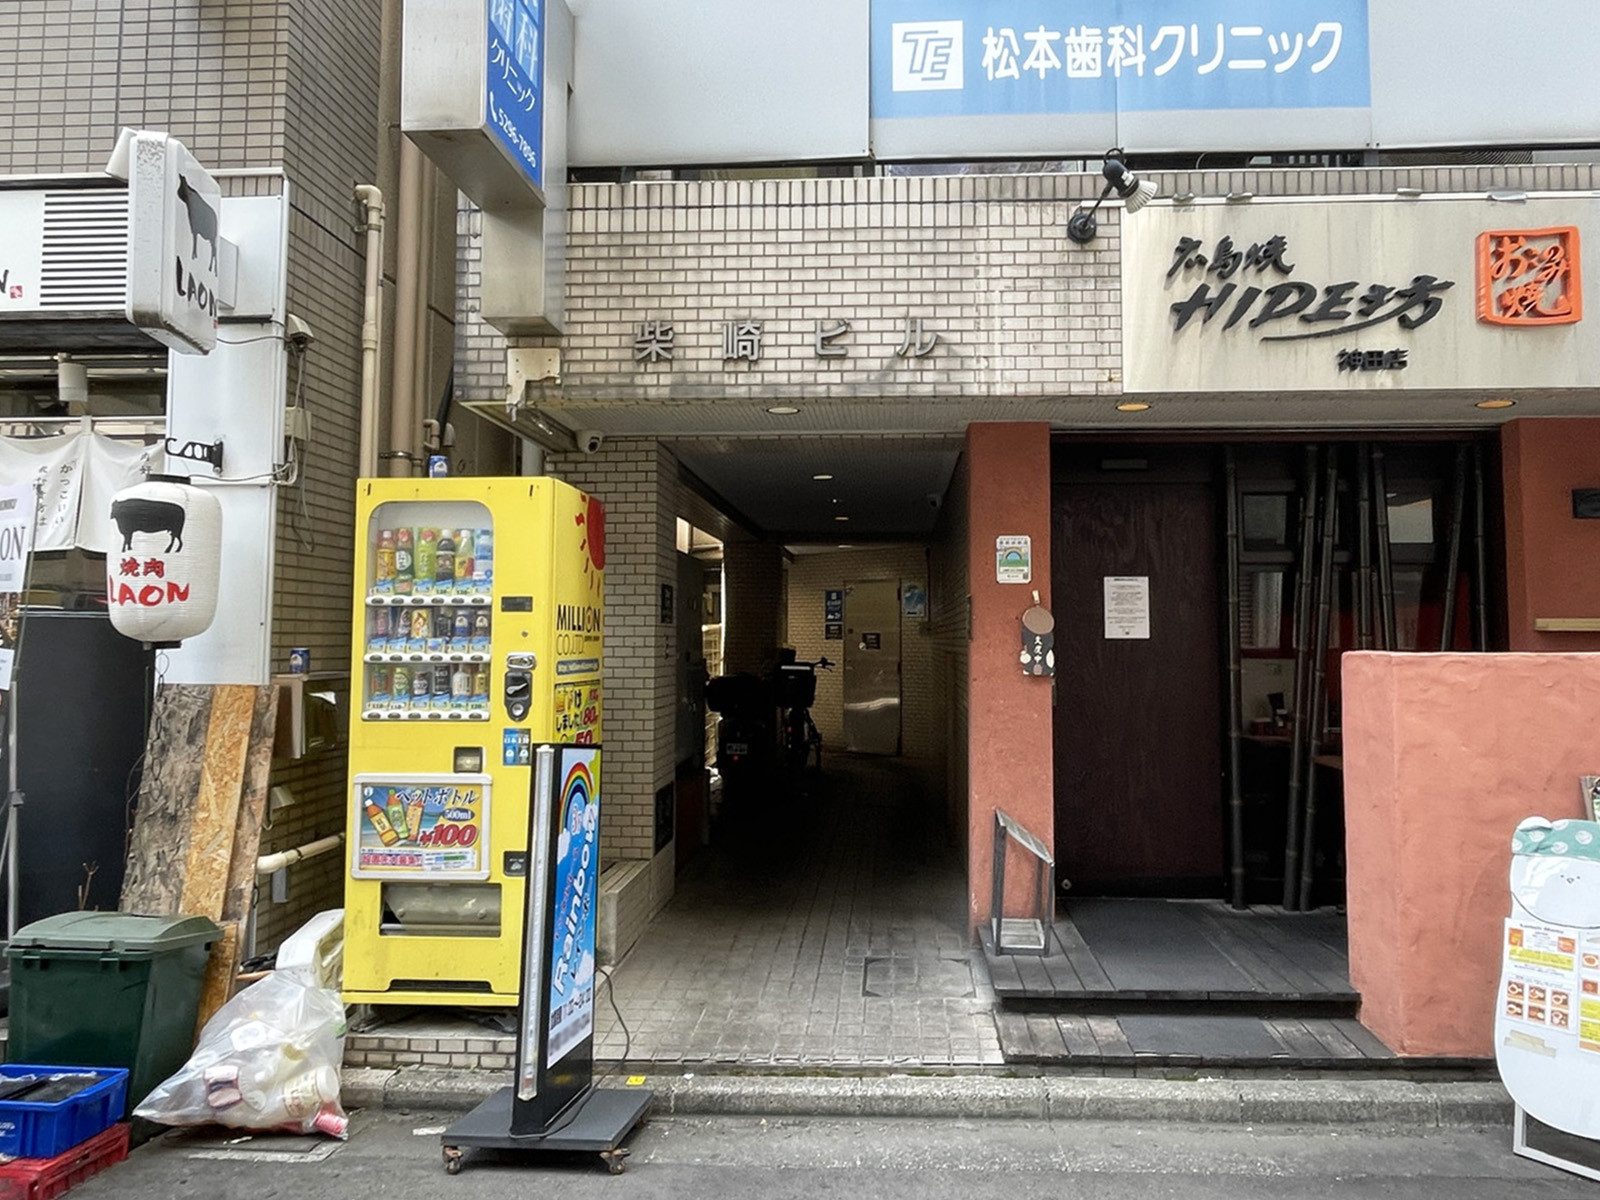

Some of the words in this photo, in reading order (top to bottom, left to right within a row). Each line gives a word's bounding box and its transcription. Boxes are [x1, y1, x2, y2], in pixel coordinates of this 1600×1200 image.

[981, 23, 1342, 80] 松本歯科クリニック
[490, 38, 536, 112] クリニック
[176, 255, 217, 317] LAON
[633, 318, 940, 363] 柴崎ビル
[1336, 348, 1409, 373] 神田店
[120, 556, 165, 579] 焼肉
[109, 574, 190, 607] LAON
[556, 604, 600, 633] MILLION
[396, 788, 478, 805] ペットボトル
[445, 811, 472, 820] 500ml
[420, 824, 478, 846] ¥100
[553, 804, 598, 996] Rainbow
